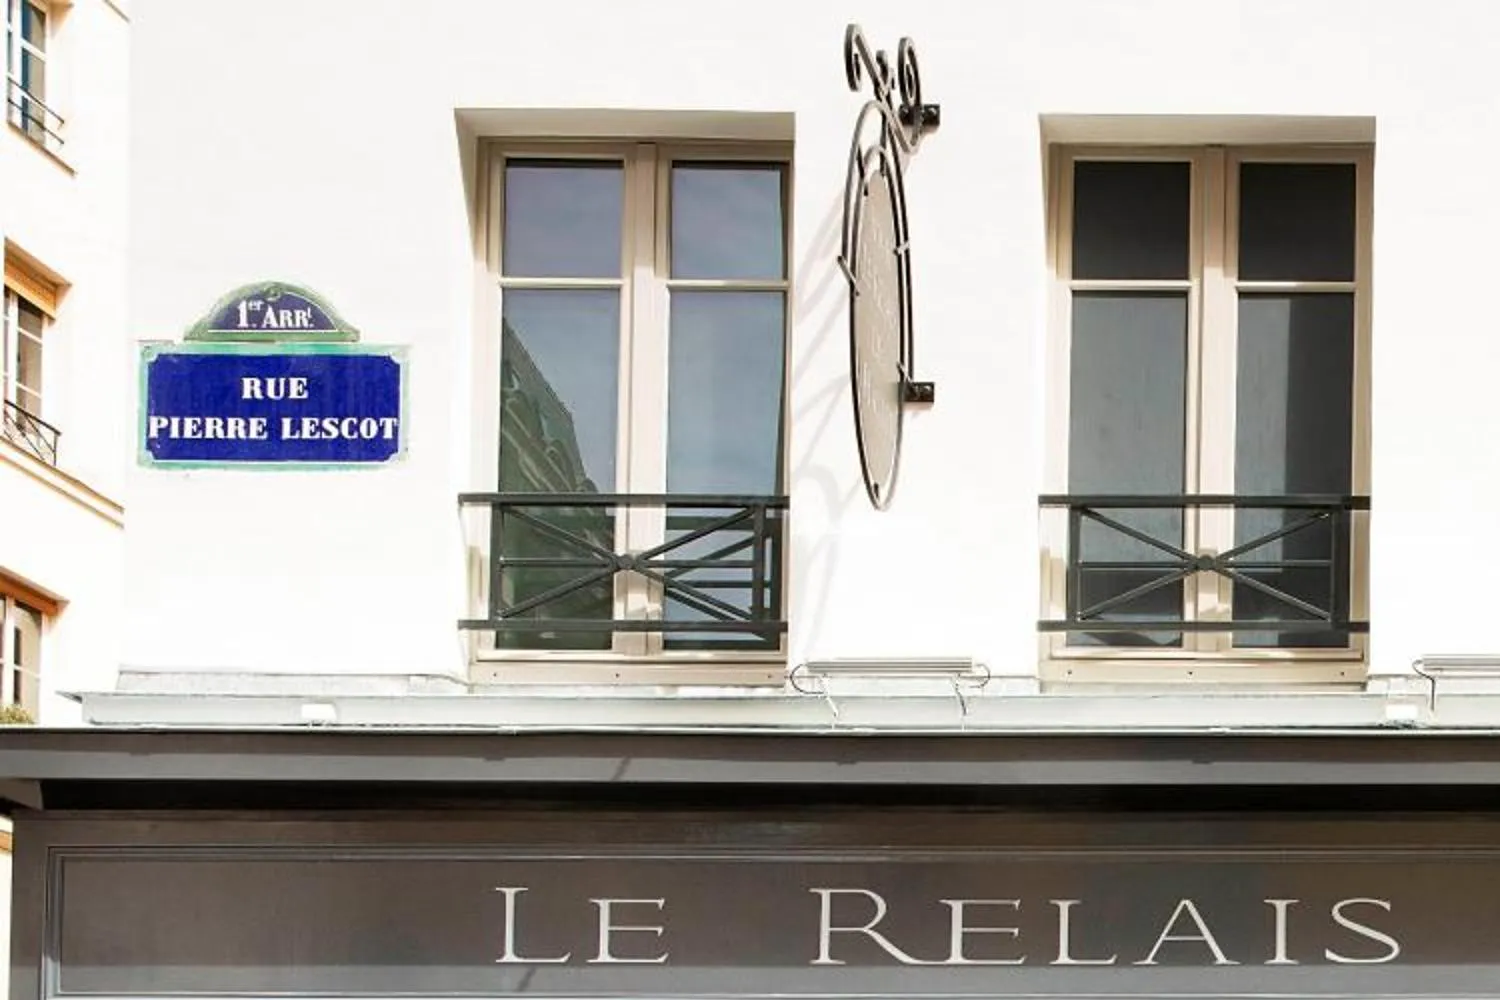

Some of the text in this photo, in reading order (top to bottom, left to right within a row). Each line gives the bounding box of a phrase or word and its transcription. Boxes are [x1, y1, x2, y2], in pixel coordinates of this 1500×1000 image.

[241, 376, 309, 400] RUE
[149, 415, 398, 440] PIERRE LESCOT
[495, 886, 669, 964] LE
[810, 887, 1401, 965] RELAIS
